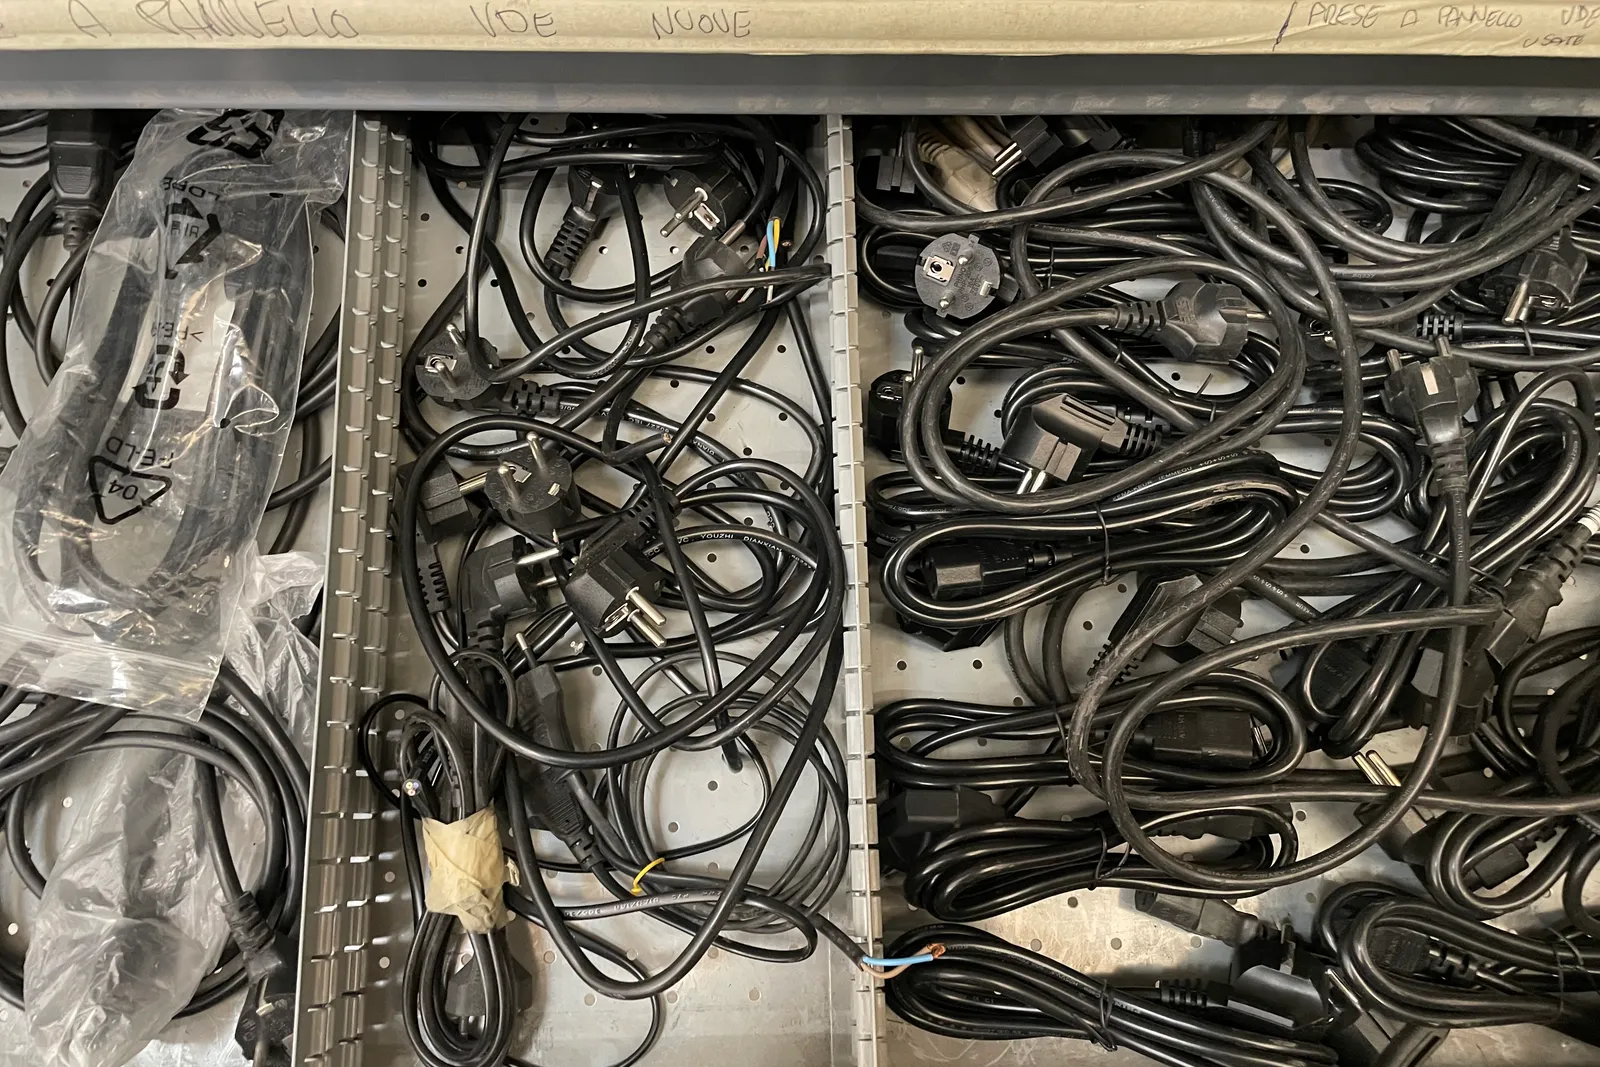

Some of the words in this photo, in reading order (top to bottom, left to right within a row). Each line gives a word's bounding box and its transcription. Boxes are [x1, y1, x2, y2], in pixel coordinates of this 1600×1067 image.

[652, 6, 750, 40] NUOVE
[1308, 2, 1383, 28] PRESE
[108, 478, 138, 500] 04
